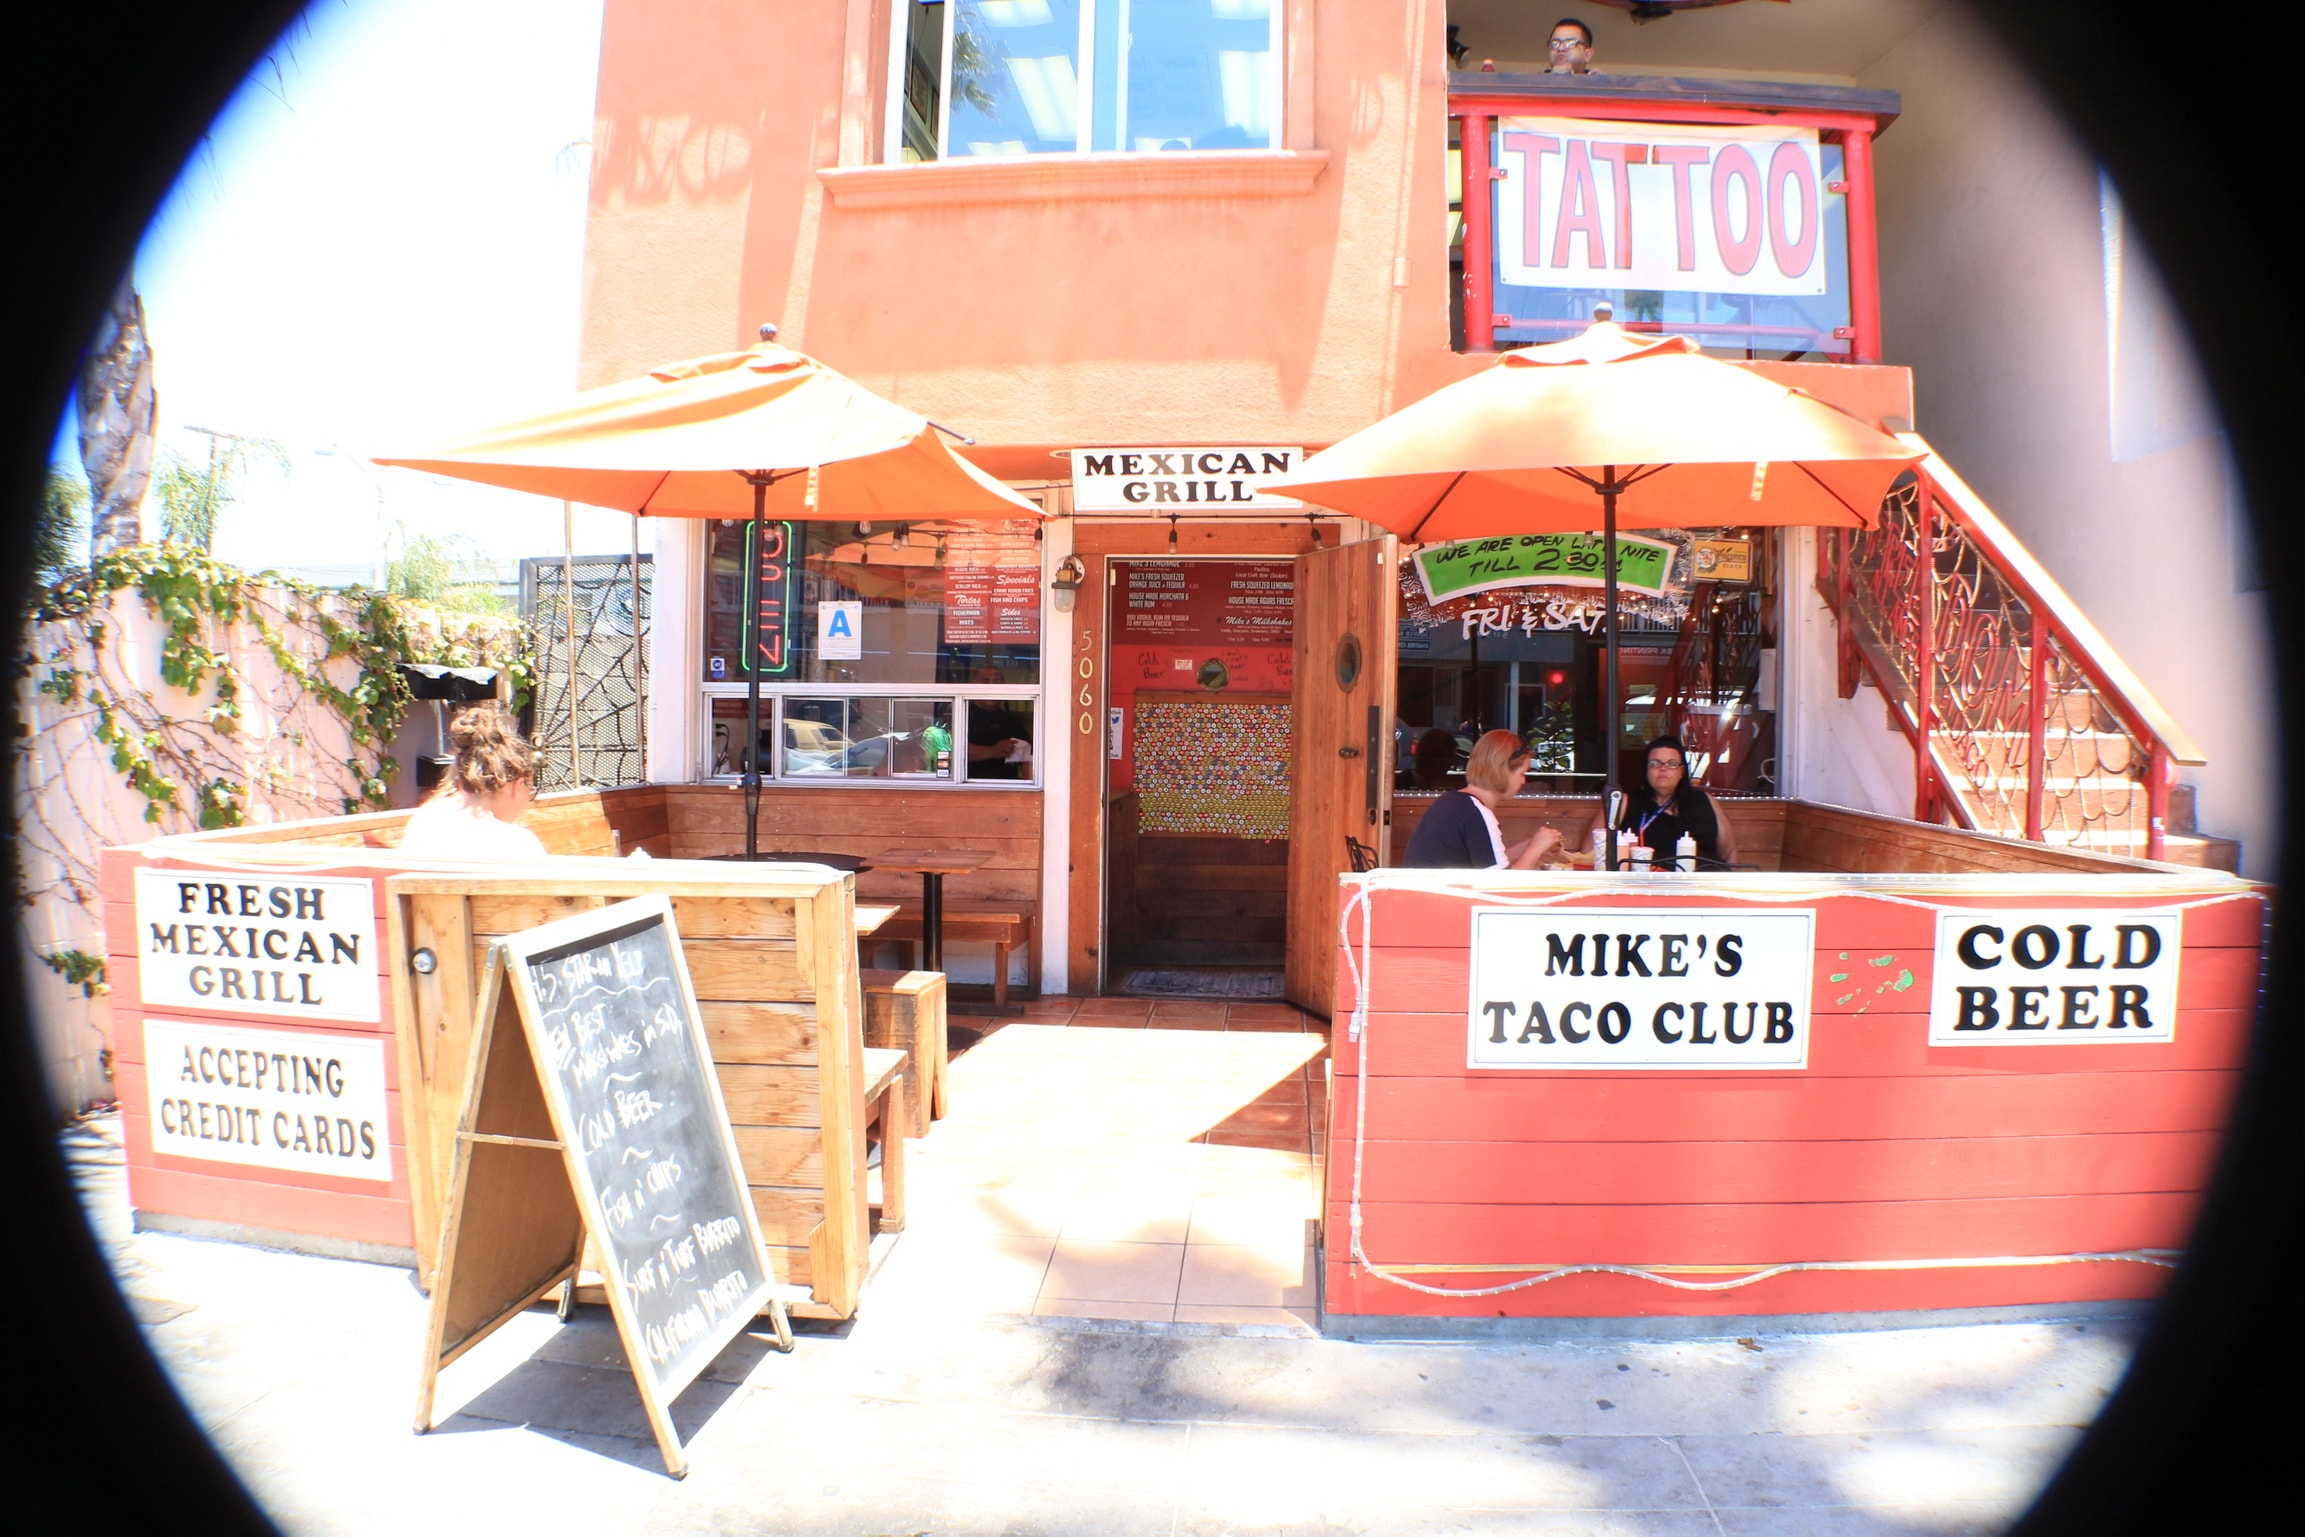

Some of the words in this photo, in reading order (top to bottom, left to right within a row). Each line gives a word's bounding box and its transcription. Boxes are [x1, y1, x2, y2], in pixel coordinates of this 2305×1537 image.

[1502, 132, 1818, 278] TATTOO
[1084, 452, 1290, 476] MEXICAN
[1122, 480, 1253, 503] GRILL
[1436, 545, 1471, 564] WE
[1474, 537, 1514, 556] ARE
[1520, 535, 1564, 547] OPEN
[1571, 537, 1606, 552] LAT
[1620, 545, 1660, 562] NITE
[996, 574, 1035, 586] Specials
[1129, 573, 1145, 581] MIKE'S
[1145, 573, 1160, 581] FRESH
[1161, 573, 1185, 581] SQUEEZED
[1469, 555, 1521, 577] TILL
[1129, 580, 1148, 588] ORANGE
[1148, 580, 1161, 588] JUICE
[1166, 581, 1186, 589] TEQUILA
[1129, 592, 1145, 600] HOUSE
[1145, 592, 1158, 600] MADE
[1230, 580, 1246, 589] FRESH
[1246, 581, 1270, 590] SQUEEZED
[1270, 581, 1294, 590] LEMONAD
[954, 594, 981, 605] Tortas
[1000, 608, 1021, 616] Sides
[1129, 600, 1144, 608] WHITE
[1144, 600, 1155, 608] RUM
[1228, 596, 1245, 604] HOUSE
[1245, 596, 1259, 604] MADE
[1259, 597, 1276, 605] AGUAS
[827, 609, 852, 637] A
[1225, 615, 1250, 625] Mike's
[1252, 616, 1293, 626] Milkshakes
[1521, 605, 1538, 638] &
[1138, 651, 1159, 666] Cold
[1079, 630, 1094, 735] 5060
[178, 882, 325, 921] FRESH
[150, 922, 360, 965] MEXICAN
[1545, 933, 1744, 978] MIKE'S
[1957, 924, 2162, 970] COLD
[189, 966, 323, 1006] GRILL
[1953, 983, 2155, 1032] BEER
[1482, 1001, 1632, 1046] TACO
[1652, 1001, 1795, 1046] CLUB
[180, 1044, 344, 1099] ACCEPTING
[613, 1090, 663, 1129] BEER
[161, 1097, 262, 1146] CREDIT
[273, 1111, 375, 1160] CARDS
